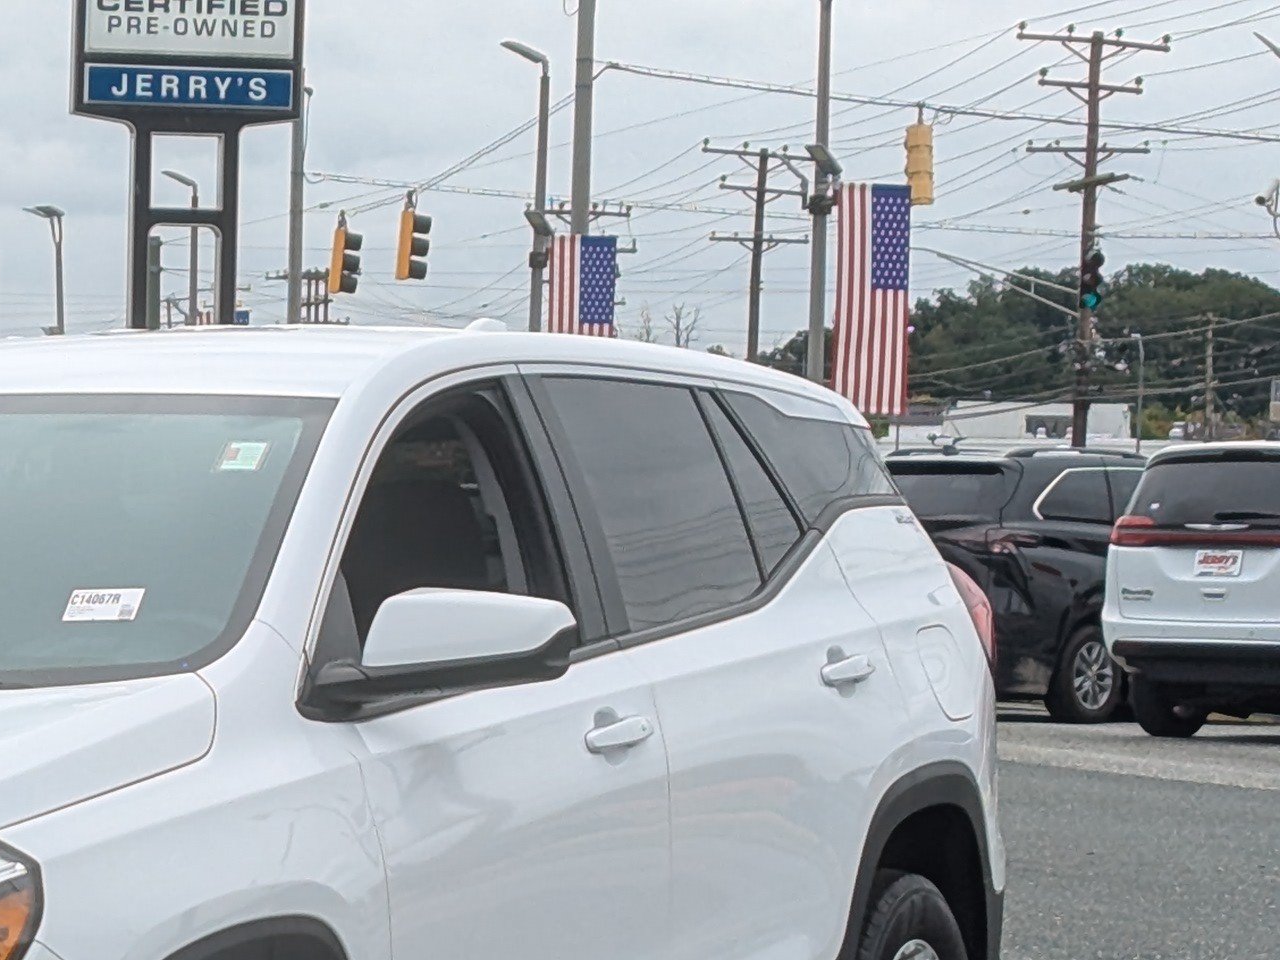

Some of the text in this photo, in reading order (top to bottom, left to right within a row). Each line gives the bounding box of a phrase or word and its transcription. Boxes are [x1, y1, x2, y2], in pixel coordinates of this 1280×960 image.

[97, 0, 288, 16] CERTIFIED
[107, 15, 276, 38] PRE-OWNED
[111, 73, 268, 100] JERRY'S
